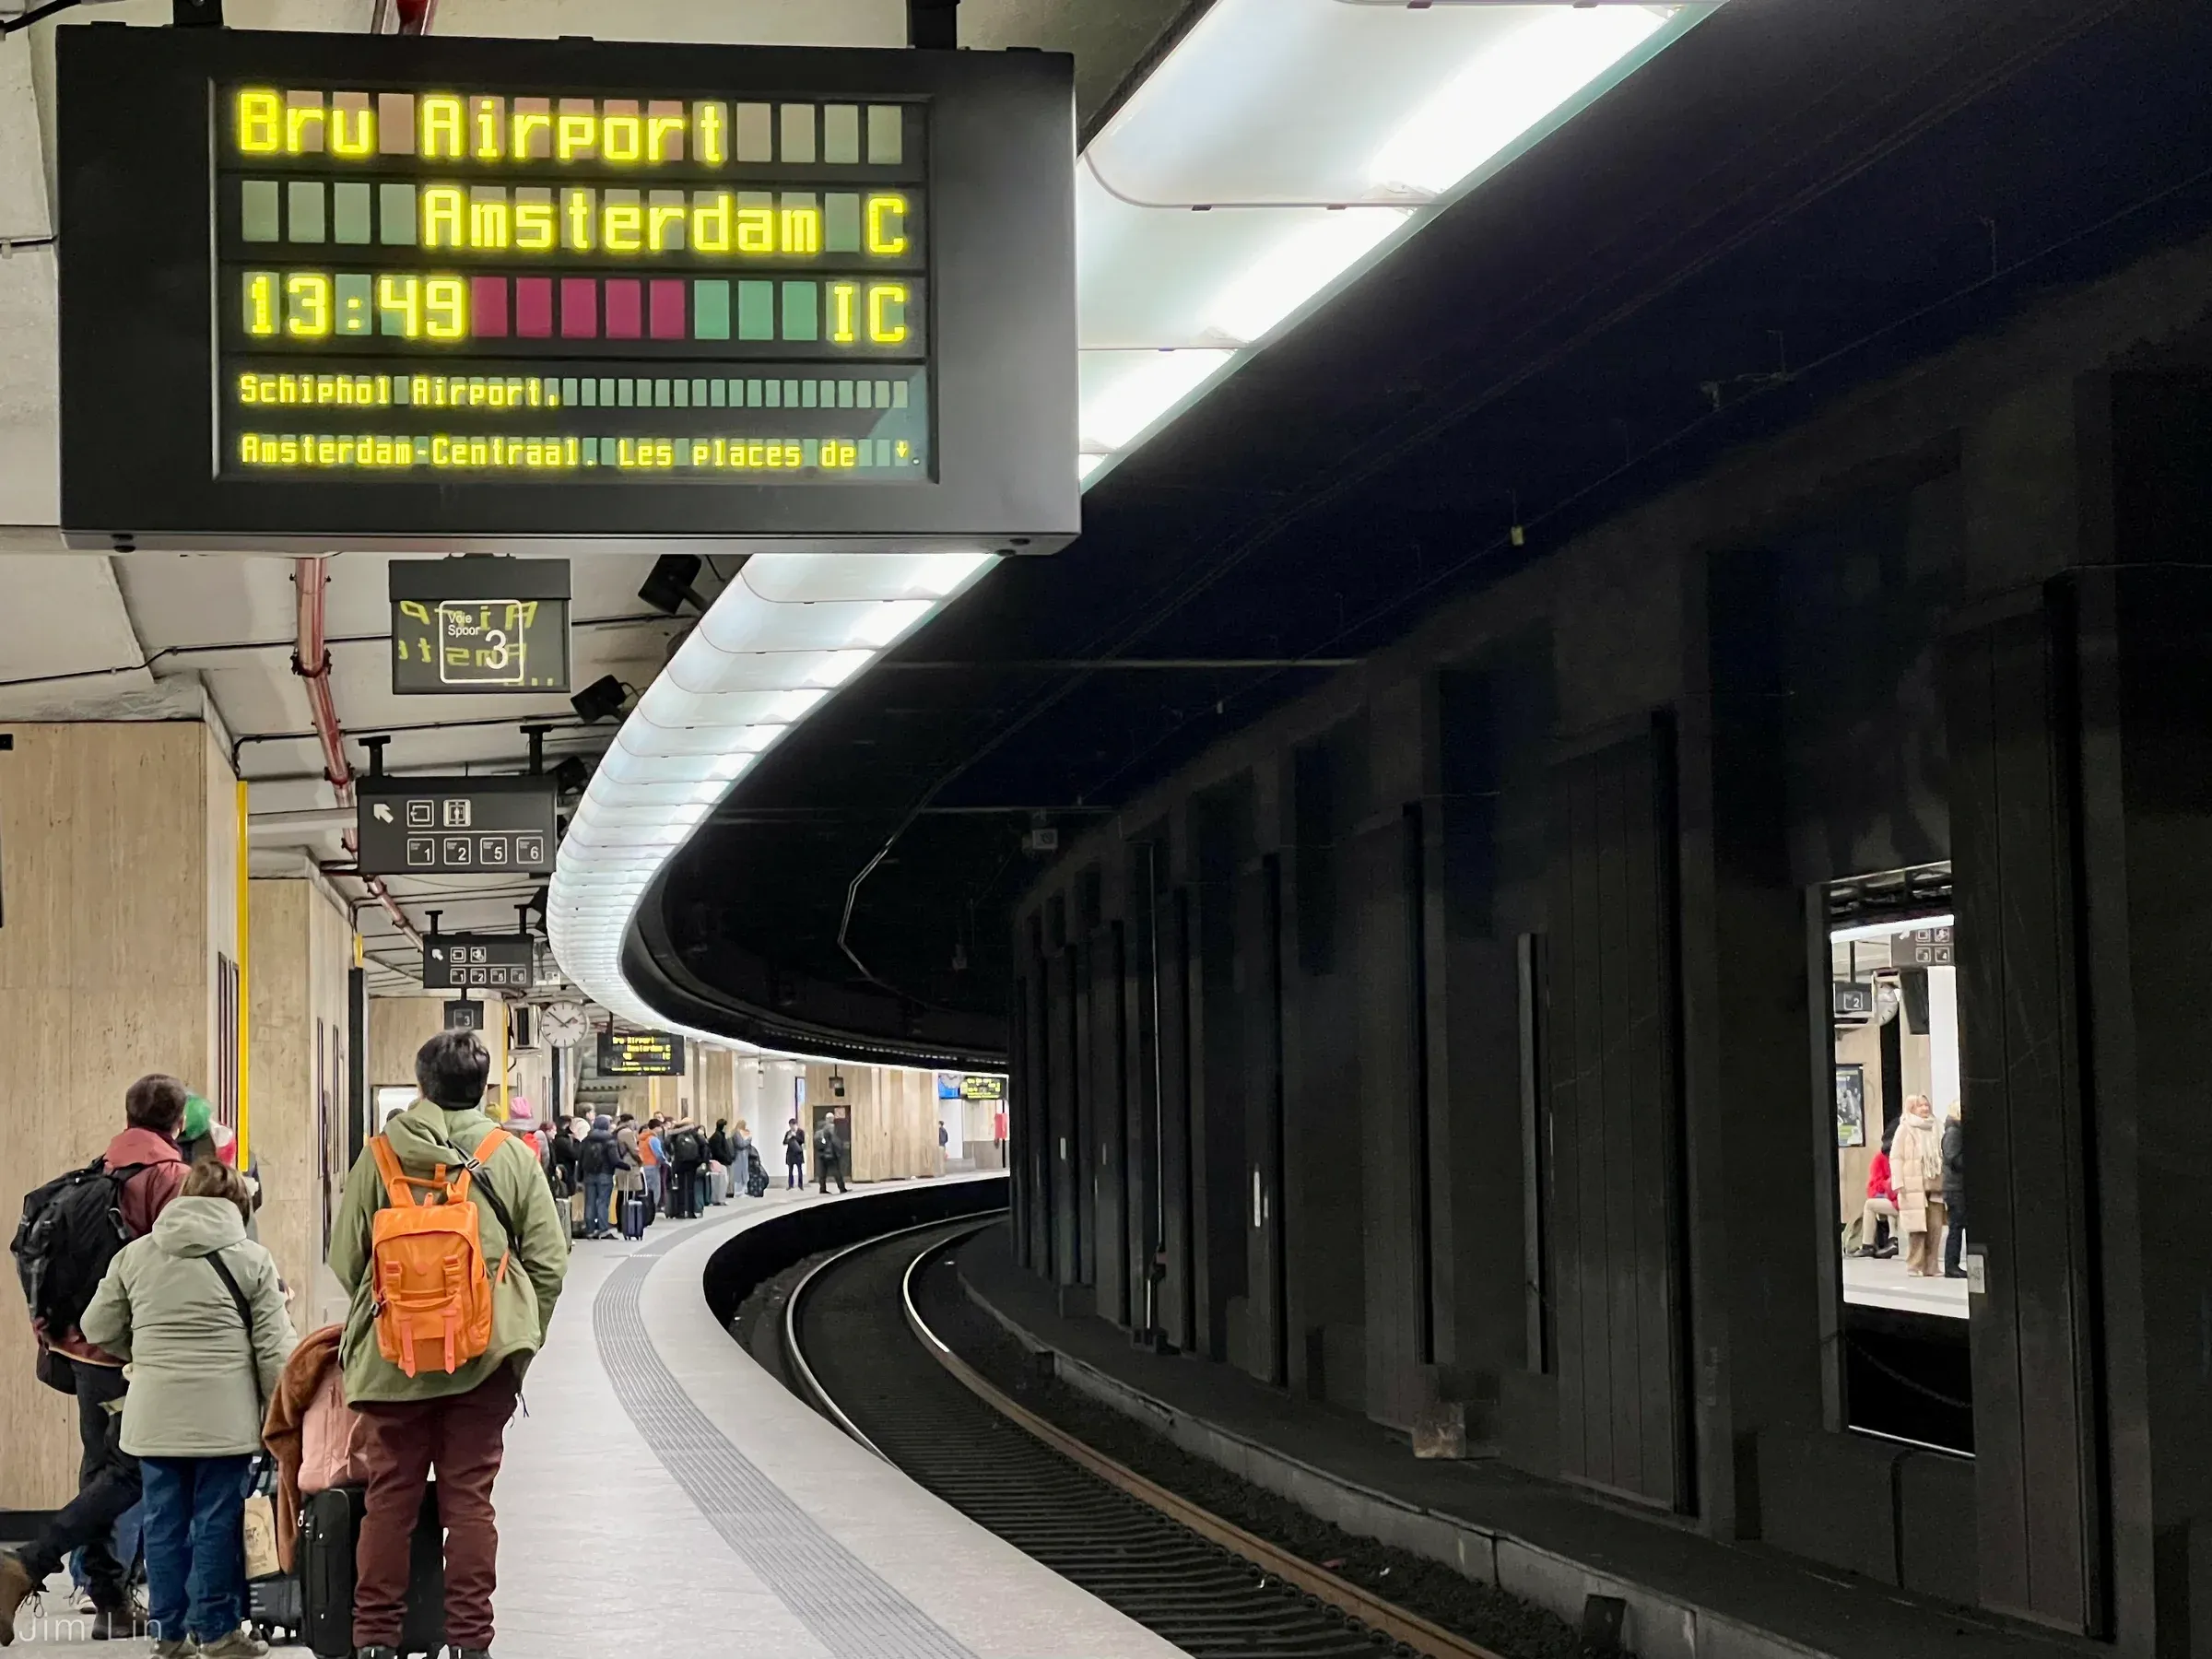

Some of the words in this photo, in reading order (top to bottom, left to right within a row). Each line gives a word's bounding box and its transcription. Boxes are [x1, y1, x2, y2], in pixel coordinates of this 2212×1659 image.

[238, 90, 374, 156] Bru
[420, 95, 725, 164] Airport
[421, 188, 820, 253] Amsterdam
[866, 195, 906, 254] C
[247, 274, 467, 340] 13:49
[831, 284, 907, 342] IC
[240, 375, 391, 404] Schiphol
[618, 438, 673, 466] Les
[693, 440, 802, 467] places
[821, 441, 856, 467] de
[448, 612, 472, 624] Voie
[447, 626, 480, 638] Spoor
[485, 629, 509, 670] 3
[424, 848, 430, 862] 1
[458, 847, 466, 862] 2
[494, 846, 503, 861] 5
[530, 845, 539, 860] 6
[460, 974, 465, 982] 1
[477, 973, 484, 982] 2
[1853, 998, 1860, 1007] 2
[464, 1016, 471, 1026] 3
